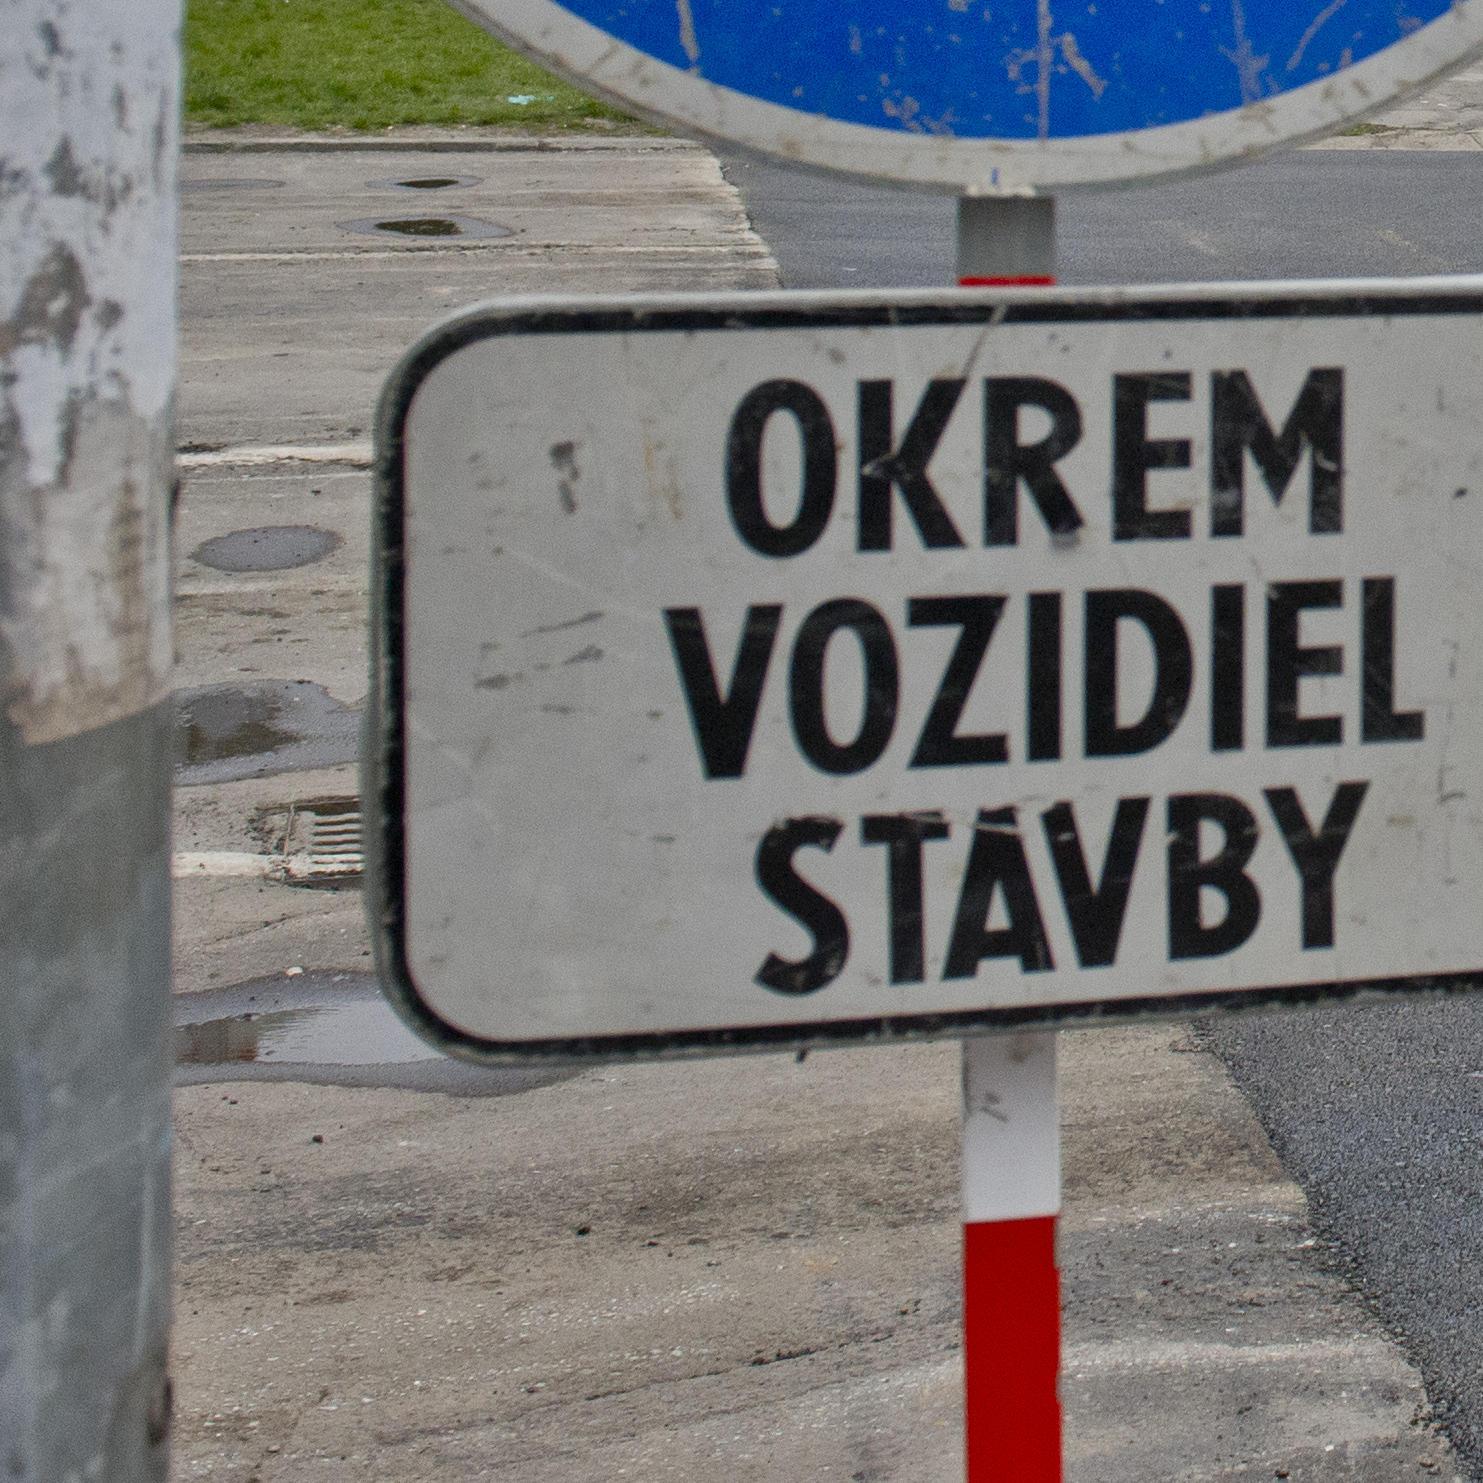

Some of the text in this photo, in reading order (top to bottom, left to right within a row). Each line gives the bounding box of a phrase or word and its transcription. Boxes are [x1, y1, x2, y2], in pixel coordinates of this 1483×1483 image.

[724, 366, 1346, 560] OKREM
[663, 576, 1427, 782] VOZIDIEL
[751, 780, 1371, 997] STAVBY
